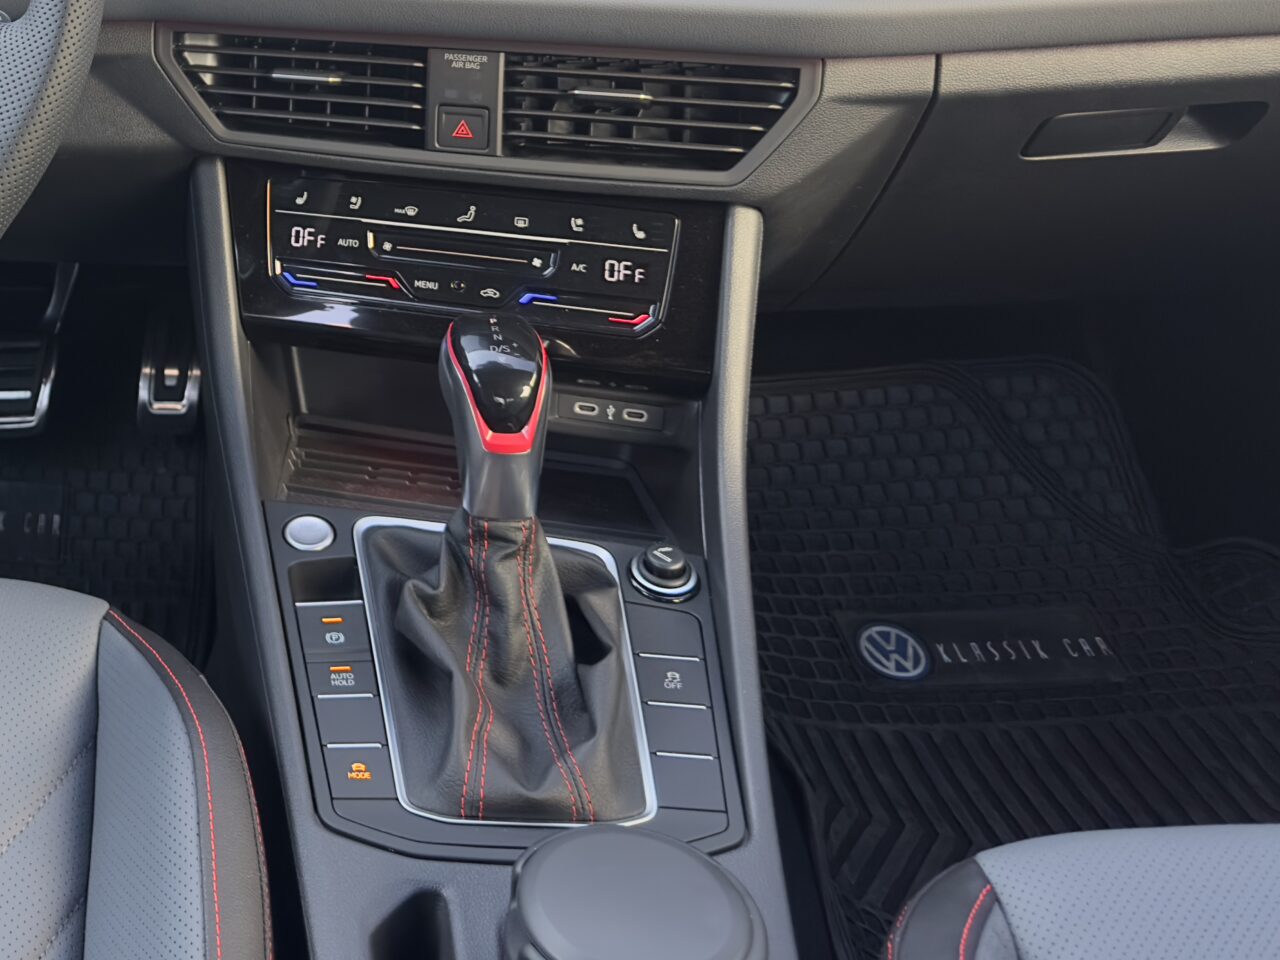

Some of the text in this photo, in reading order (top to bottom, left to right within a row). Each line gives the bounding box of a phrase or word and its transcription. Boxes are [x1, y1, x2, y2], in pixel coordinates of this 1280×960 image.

[444, 53, 488, 63] PASSENGER
[465, 62, 480, 70] BAG
[337, 238, 360, 248] AUTO
[570, 263, 588, 273] A/C
[414, 279, 439, 290] MENU
[493, 333, 503, 341] N
[489, 344, 511, 353] D/S
[23, 511, 61, 536] CAR
[935, 639, 1049, 663] KLASSIK
[1062, 636, 1114, 657] CAR
[664, 681, 683, 690] OFF
[347, 771, 373, 780] MODE
